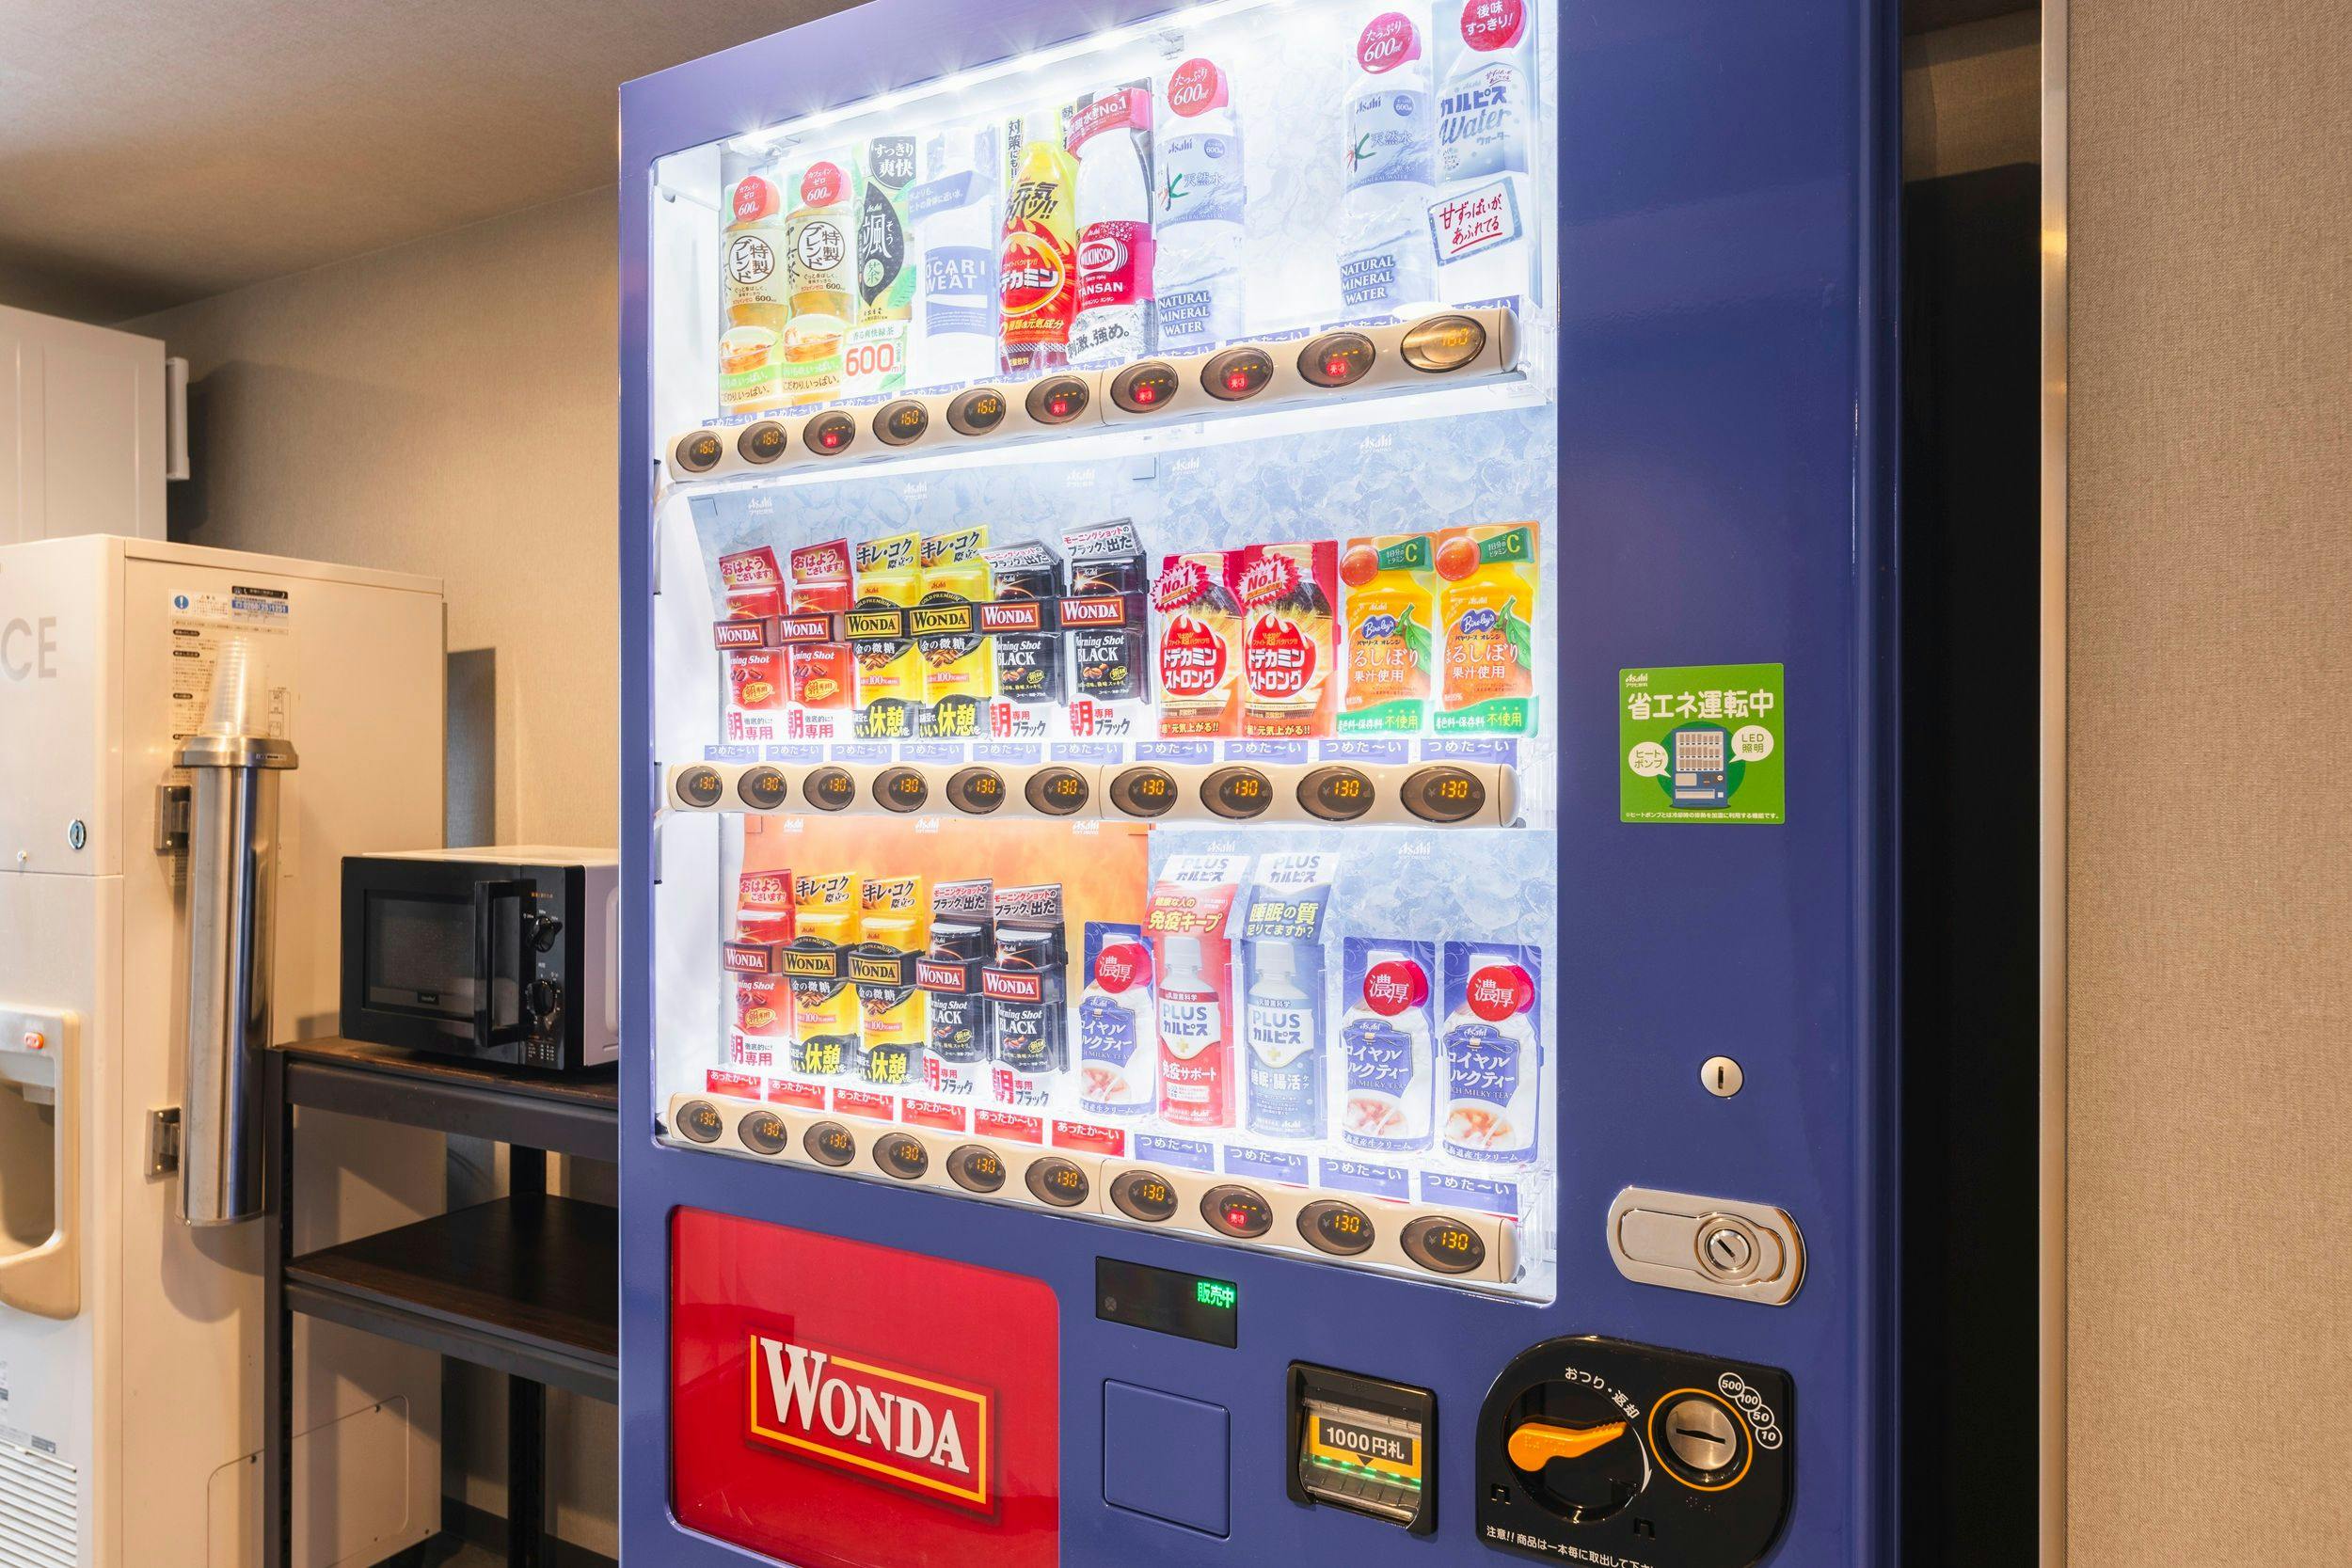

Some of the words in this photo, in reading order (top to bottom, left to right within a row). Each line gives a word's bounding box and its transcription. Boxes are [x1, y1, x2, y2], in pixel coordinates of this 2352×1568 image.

[1477, 1, 1503, 19] 後味
[1365, 21, 1402, 43] たっぷり
[1466, 14, 1514, 36] すっきり!
[1099, 96, 1126, 117] No.1
[1356, 96, 1381, 114] Asahi
[1440, 86, 1507, 119] カルピス
[1439, 108, 1512, 147] Water
[874, 143, 914, 157] すっきり
[880, 159, 914, 178] 爽快
[1014, 182, 1058, 202] 元気
[863, 214, 892, 260] 颯
[1452, 215, 1500, 245] あふれてる
[804, 225, 824, 269] ブレンド
[822, 230, 840, 261] 特製
[734, 239, 752, 282] ブレンド
[750, 245, 771, 276] 特製
[1341, 255, 1395, 278] NATURAL
[867, 262, 881, 284] 茶
[1342, 271, 1393, 293] MINERAL
[1158, 291, 1210, 309] NATURAL
[1345, 287, 1387, 307] WATER
[1159, 306, 1210, 325] MINERAL
[1164, 321, 1203, 338] WATER
[1066, 324, 1130, 359] 刺激、強め。
[977, 398, 996, 415] 160
[900, 410, 919, 425] 160
[762, 431, 779, 446] 160
[1063, 526, 1130, 545] モーニングショットの
[857, 538, 913, 565] キレ・コク
[921, 531, 979, 560] キレ・コク
[1405, 544, 1418, 562] C
[722, 558, 764, 576] おはよう
[794, 549, 836, 570] おはよう
[737, 569, 772, 582] ございます!
[806, 562, 843, 576] ございます!
[1248, 564, 1279, 592] No.1
[1162, 568, 1192, 596] No.1
[913, 610, 967, 628] WONDA
[983, 606, 1034, 626] WONDA
[1062, 599, 1119, 621] WONDA
[782, 620, 824, 638] WONDA
[849, 615, 896, 632] WONDA
[717, 626, 758, 643] WONDA
[1102, 634, 1124, 645] Shot
[856, 642, 896, 654] 金の微糖
[921, 637, 965, 651] 金の微糖
[1021, 641, 1041, 651] Shot
[814, 651, 834, 659] Shot
[997, 652, 1037, 666] BLACK
[1077, 646, 1119, 662] BLACK
[1164, 647, 1216, 669] ドデカミン
[1248, 648, 1305, 670] ドデカミン
[1355, 649, 1419, 668] るしぼり
[1165, 670, 1215, 689] ストロング
[1250, 670, 1302, 690] ストロング
[1355, 669, 1405, 684] 果汁使用
[1453, 666, 1505, 679] 果汁使用
[1626, 673, 1648, 683] Asahi
[1628, 689, 1773, 721] 省エネ運転中
[788, 709, 803, 739] 朝
[990, 704, 1011, 737] 朝
[1013, 710, 1030, 721] 専用
[1070, 701, 1094, 736] 朝
[1385, 715, 1418, 729] 不使用
[1486, 712, 1522, 727] 不使用
[745, 726, 773, 741] 専用
[805, 724, 834, 738] 専用
[1012, 721, 1046, 736] ブラック
[1095, 719, 1131, 736] ブラック
[1741, 733, 1765, 742] LED
[1636, 749, 1662, 758] ヒート
[1741, 744, 1764, 753] 照明
[1634, 758, 1663, 769] ポンプ
[1334, 780, 1359, 798] 130
[1441, 780, 1469, 799] 130
[1182, 856, 1229, 869] PLUS
[1273, 855, 1321, 869] PLUS
[1176, 871, 1225, 882] カルピス
[1270, 871, 1317, 883] カルピス
[740, 879, 781, 894] おはよう
[796, 876, 849, 897] キレ・コク
[864, 879, 914, 902] キレ・コク
[934, 886, 988, 896] モーニングショットの
[751, 893, 786, 902] ございます!
[994, 891, 1056, 903] モーニングショットの
[1148, 910, 1223, 932] 免疫キープ
[1249, 902, 1319, 925] 睡眠の質
[1247, 924, 1314, 939] 足りてますか?
[725, 949, 764, 968] WONDA
[785, 953, 832, 972] WONDA
[1099, 956, 1133, 982] 濃厚
[792, 982, 830, 993] 金の微糖
[1369, 974, 1409, 1005] 濃厚
[1474, 978, 1514, 1008] 濃厚
[1022, 1008, 1042, 1019] Shot
[1163, 1006, 1208, 1022] PLUS
[1253, 1010, 1300, 1029] PLUS
[999, 1016, 1038, 1035] BLACK
[1164, 1022, 1209, 1037] カルピス
[1253, 1029, 1301, 1044] カルピス
[745, 1053, 772, 1066] 専用
[1347, 1064, 1408, 1081] ルクティー
[942, 1080, 973, 1095] ブラック
[1015, 1091, 1050, 1107] ブラック
[976, 1158, 995, 1174] 130
[1056, 1170, 1078, 1187] 130
[1142, 1184, 1165, 1202] 130
[1334, 1214, 1360, 1234] 130
[1440, 1231, 1470, 1251] 130
[1198, 1282, 1234, 1308] 販売中
[1565, 1366, 1640, 1419] おつり・返却
[1721, 1380, 1741, 1391] 500
[760, 1337, 970, 1474] WONDA
[1740, 1394, 1758, 1404] 100
[1753, 1411, 1770, 1422] 50
[1327, 1426, 1405, 1460] 1000円札
[1761, 1431, 1775, 1441] 10
[1486, 1525, 1515, 1543] 注意!!
